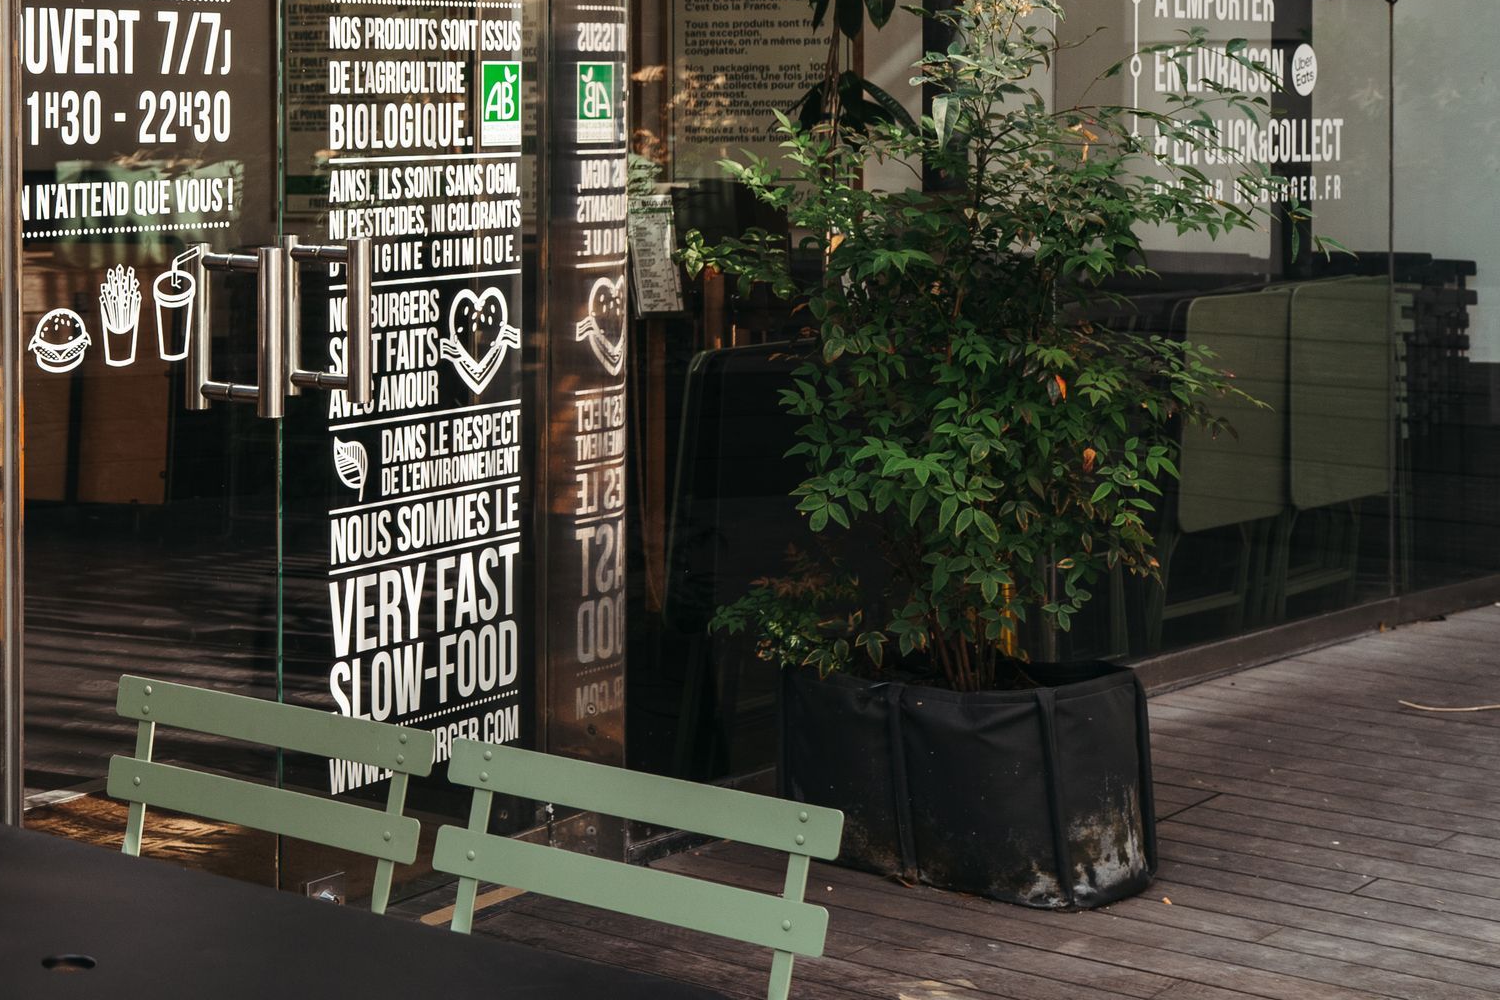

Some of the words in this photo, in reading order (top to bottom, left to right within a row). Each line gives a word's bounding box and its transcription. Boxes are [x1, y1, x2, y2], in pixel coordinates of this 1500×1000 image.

[685, 2, 710, 11] C'est
[712, 1, 729, 11] bio
[732, 1, 740, 11] la
[744, 1, 780, 11] France.
[685, 20, 708, 29] Tous
[732, 20, 775, 29] produits
[778, 19, 800, 28] sont
[19, 7, 140, 74] UVERT
[329, 16, 361, 50] NOS
[364, 17, 438, 50] PRODUITS
[440, 18, 478, 51] SONT
[481, 19, 521, 51] ISSUS
[685, 30, 707, 38] sans
[709, 29, 762, 39] exception.
[685, 38, 699, 47] La
[700, 38, 737, 48] preuve,
[739, 38, 751, 46] on
[770, 36, 801, 46] même
[804, 38, 821, 47] pas
[685, 46, 748, 56] congélateur.
[329, 60, 350, 94] DE
[354, 61, 466, 94] L'AGRICULTURE
[685, 64, 705, 72] Nos
[713, 63, 770, 73] packagings
[779, 62, 800, 71] sont
[761, 73, 781, 81] Une
[783, 73, 801, 81] fois
[1186, 46, 1284, 93] LIVRAISON
[1294, 55, 1313, 71] Uber
[1295, 70, 1315, 87] Eats
[485, 81, 515, 120] AB
[723, 80, 768, 90] collectés
[771, 81, 794, 91] pour
[138, 90, 231, 144] 22H30
[329, 102, 473, 150] BIOLOGIQUE.
[36, 180, 128, 221] N'ATTEND
[134, 179, 171, 217] QUE
[175, 178, 222, 214] VOUS
[329, 169, 375, 204] AINSI,
[378, 167, 401, 200] ILS
[404, 166, 443, 198] SONT
[445, 164, 483, 197] SANS
[486, 162, 521, 197] OGM,
[329, 210, 345, 240] NI
[348, 204, 429, 238] PESTICIDES,
[431, 203, 445, 233] NI
[448, 200, 521, 232] COLORANTS
[431, 234, 520, 268] CHIMIQUE.
[371, 289, 440, 328] BURGERS
[386, 326, 439, 372] FAITS
[378, 370, 439, 412] AMOUR
[382, 423, 426, 465] DANS
[430, 420, 449, 457] LE
[453, 409, 521, 453] RESPECT
[382, 466, 399, 496] DE
[402, 446, 521, 493] L'ENVIRONNEMENT
[330, 510, 392, 565] NOUS
[397, 491, 490, 551] SOMMES
[496, 485, 519, 531] LE
[329, 562, 426, 658] VERY
[436, 541, 520, 633] FAST
[329, 619, 518, 722] SLOW-FOOD
